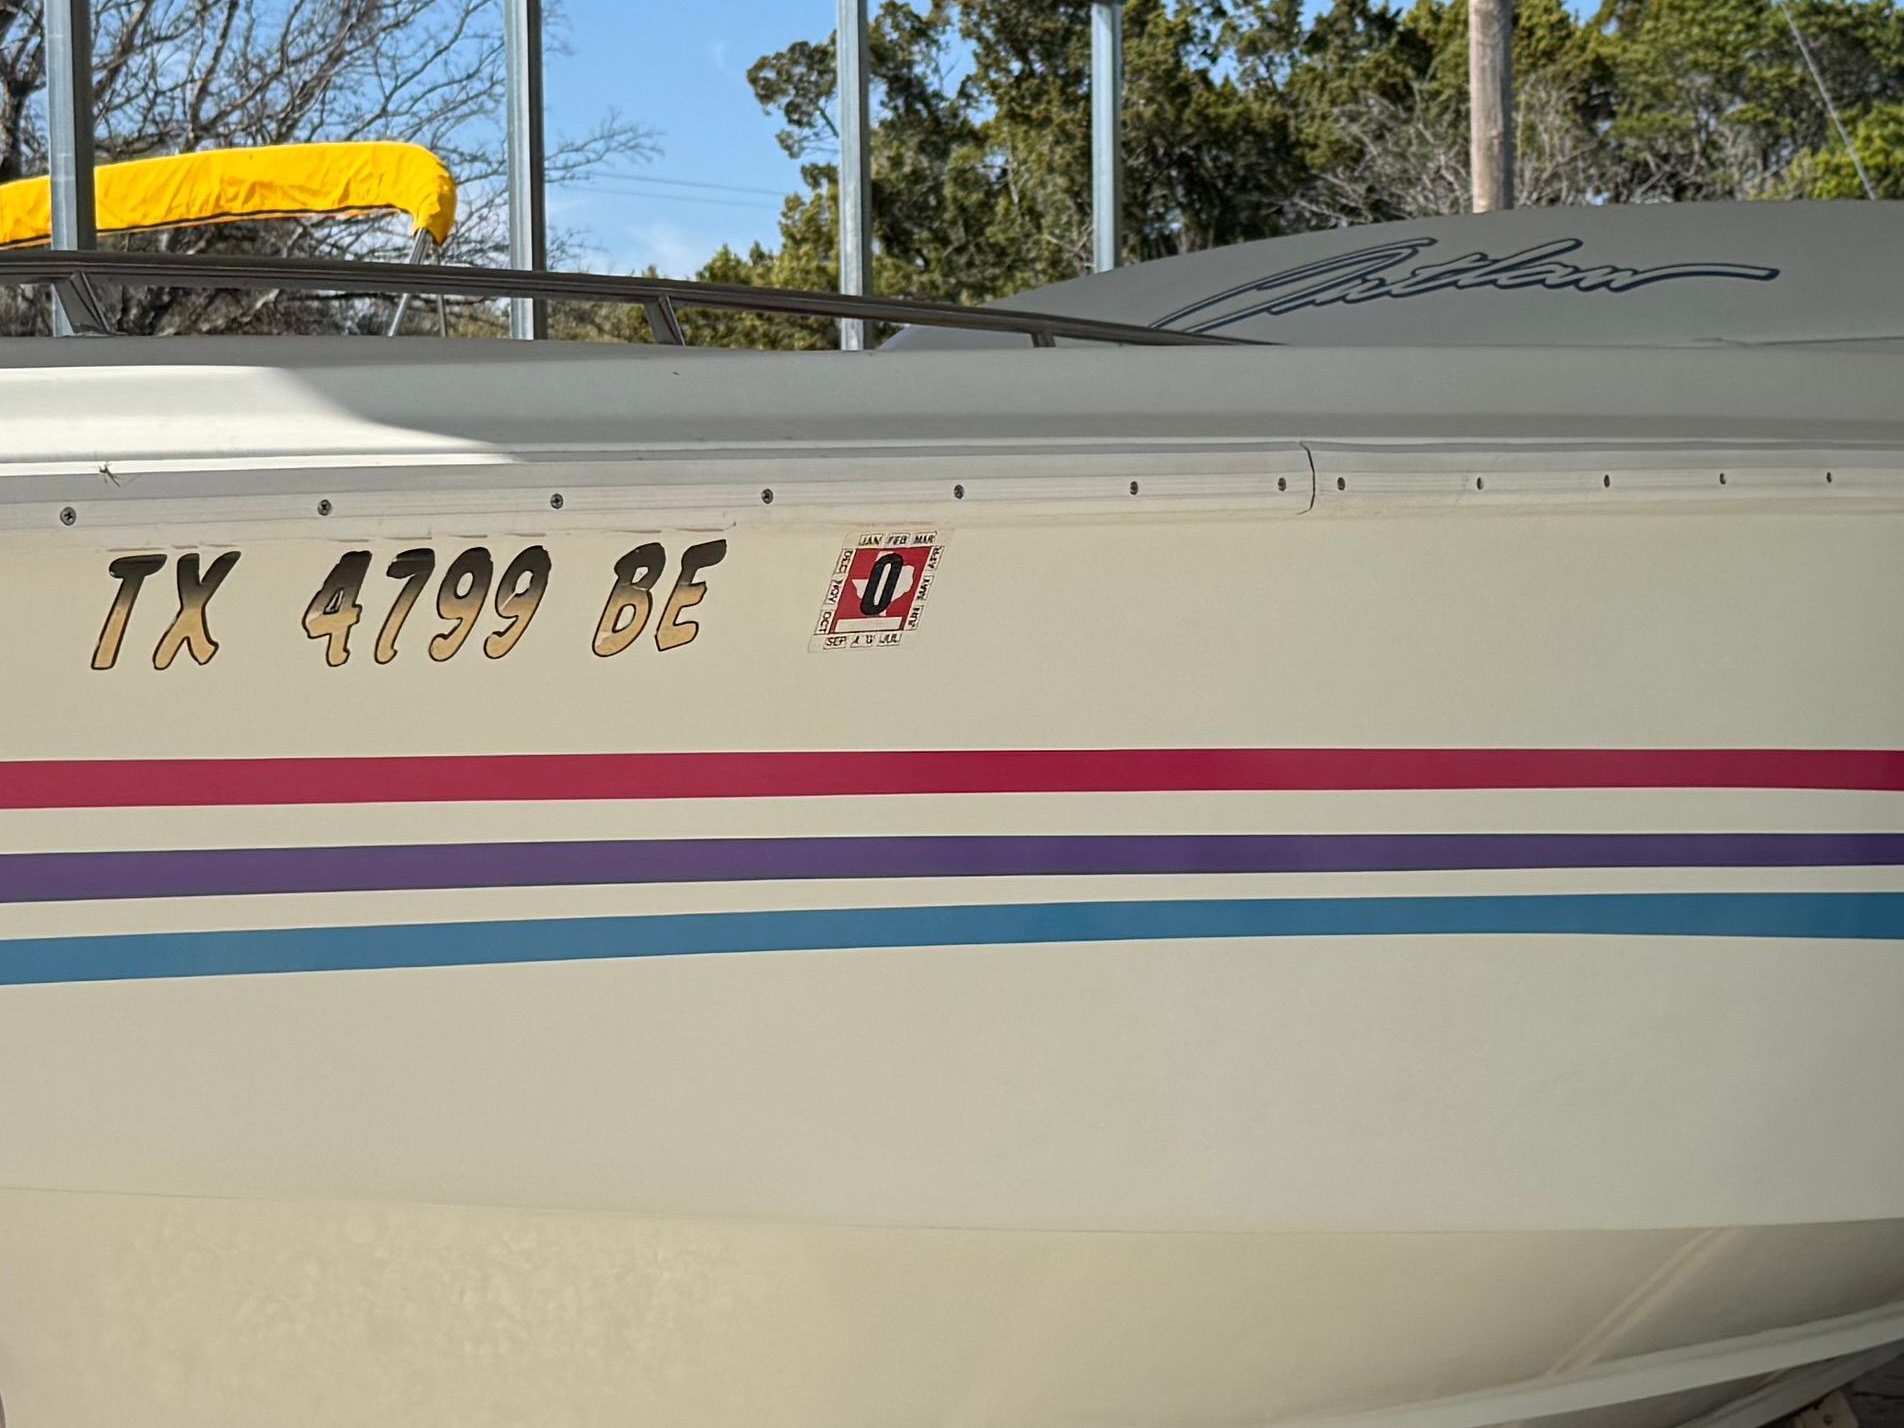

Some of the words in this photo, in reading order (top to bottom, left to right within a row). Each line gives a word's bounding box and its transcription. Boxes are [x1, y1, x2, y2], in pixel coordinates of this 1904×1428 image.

[860, 534, 882, 545] JAN
[90, 550, 242, 670] TX
[301, 544, 553, 668] 4799
[591, 538, 728, 658] BE
[818, 611, 832, 633] OCT
[825, 635, 847, 647] SEP
